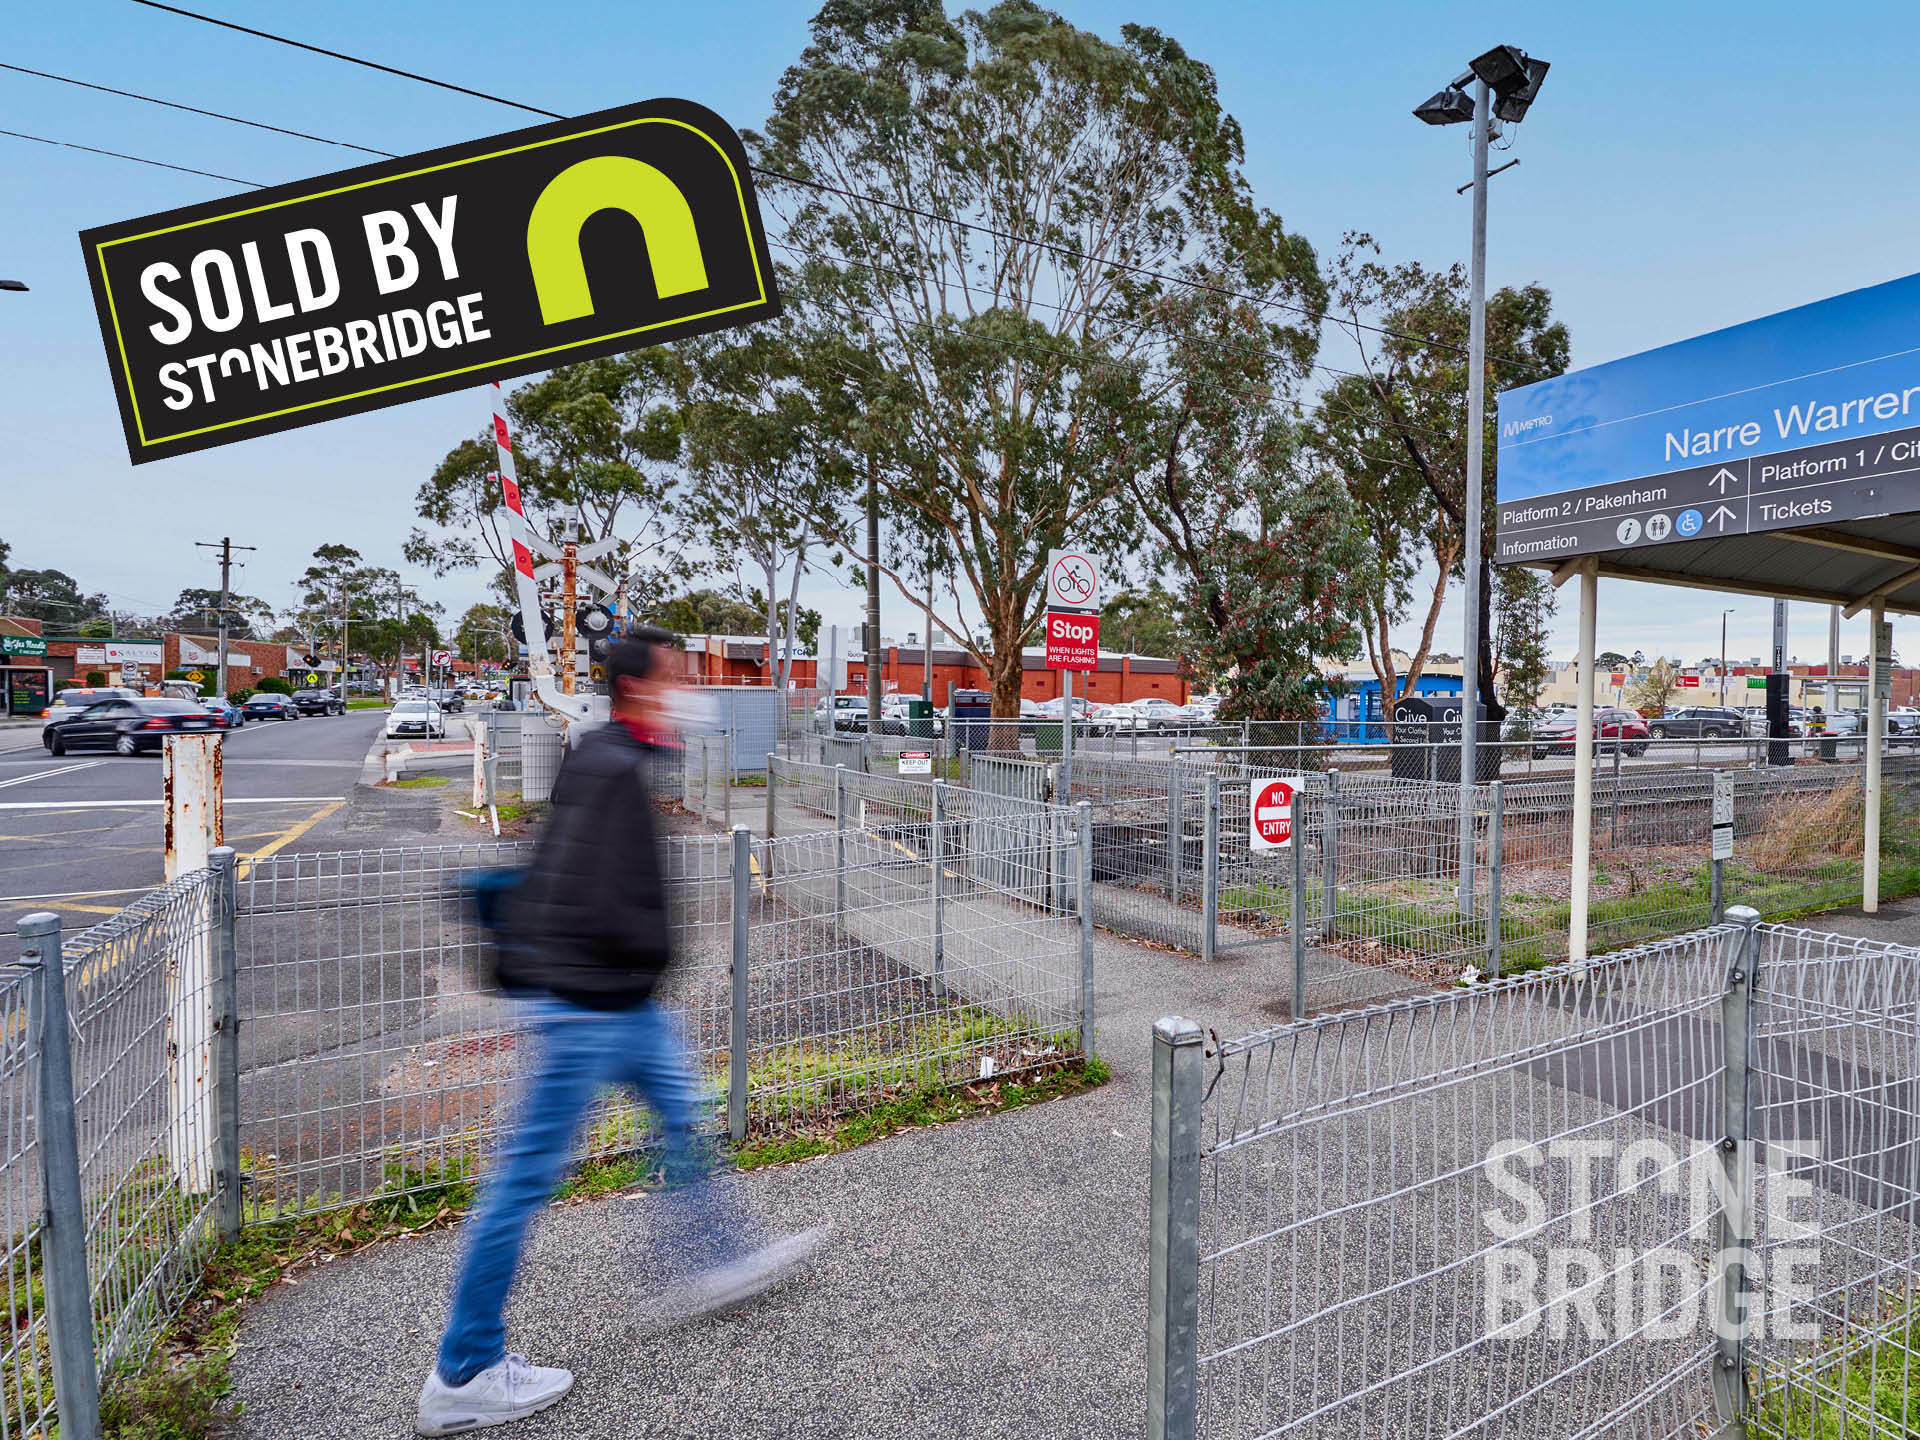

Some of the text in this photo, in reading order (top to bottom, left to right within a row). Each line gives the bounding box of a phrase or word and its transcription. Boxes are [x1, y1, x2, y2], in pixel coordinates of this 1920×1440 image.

[1520, 415, 1553, 431] METRO
[1665, 421, 1761, 462] Narre
[1760, 440, 1920, 483] Platform 1 / Cit
[1502, 487, 1667, 525] Platform 2 / Pakenham
[1760, 498, 1833, 522] Tickets
[1502, 534, 1578, 558] Information
[1052, 620, 1093, 644] Stop
[1049, 646, 1095, 656] WHEN LIGHTS
[1063, 656, 1096, 664] FLASHING
[1395, 707, 1427, 723] Give
[1443, 708, 1463, 723] Gi
[1394, 726, 1406, 734] Your
[1271, 791, 1285, 805] NO
[1263, 822, 1291, 836] ENTRY
